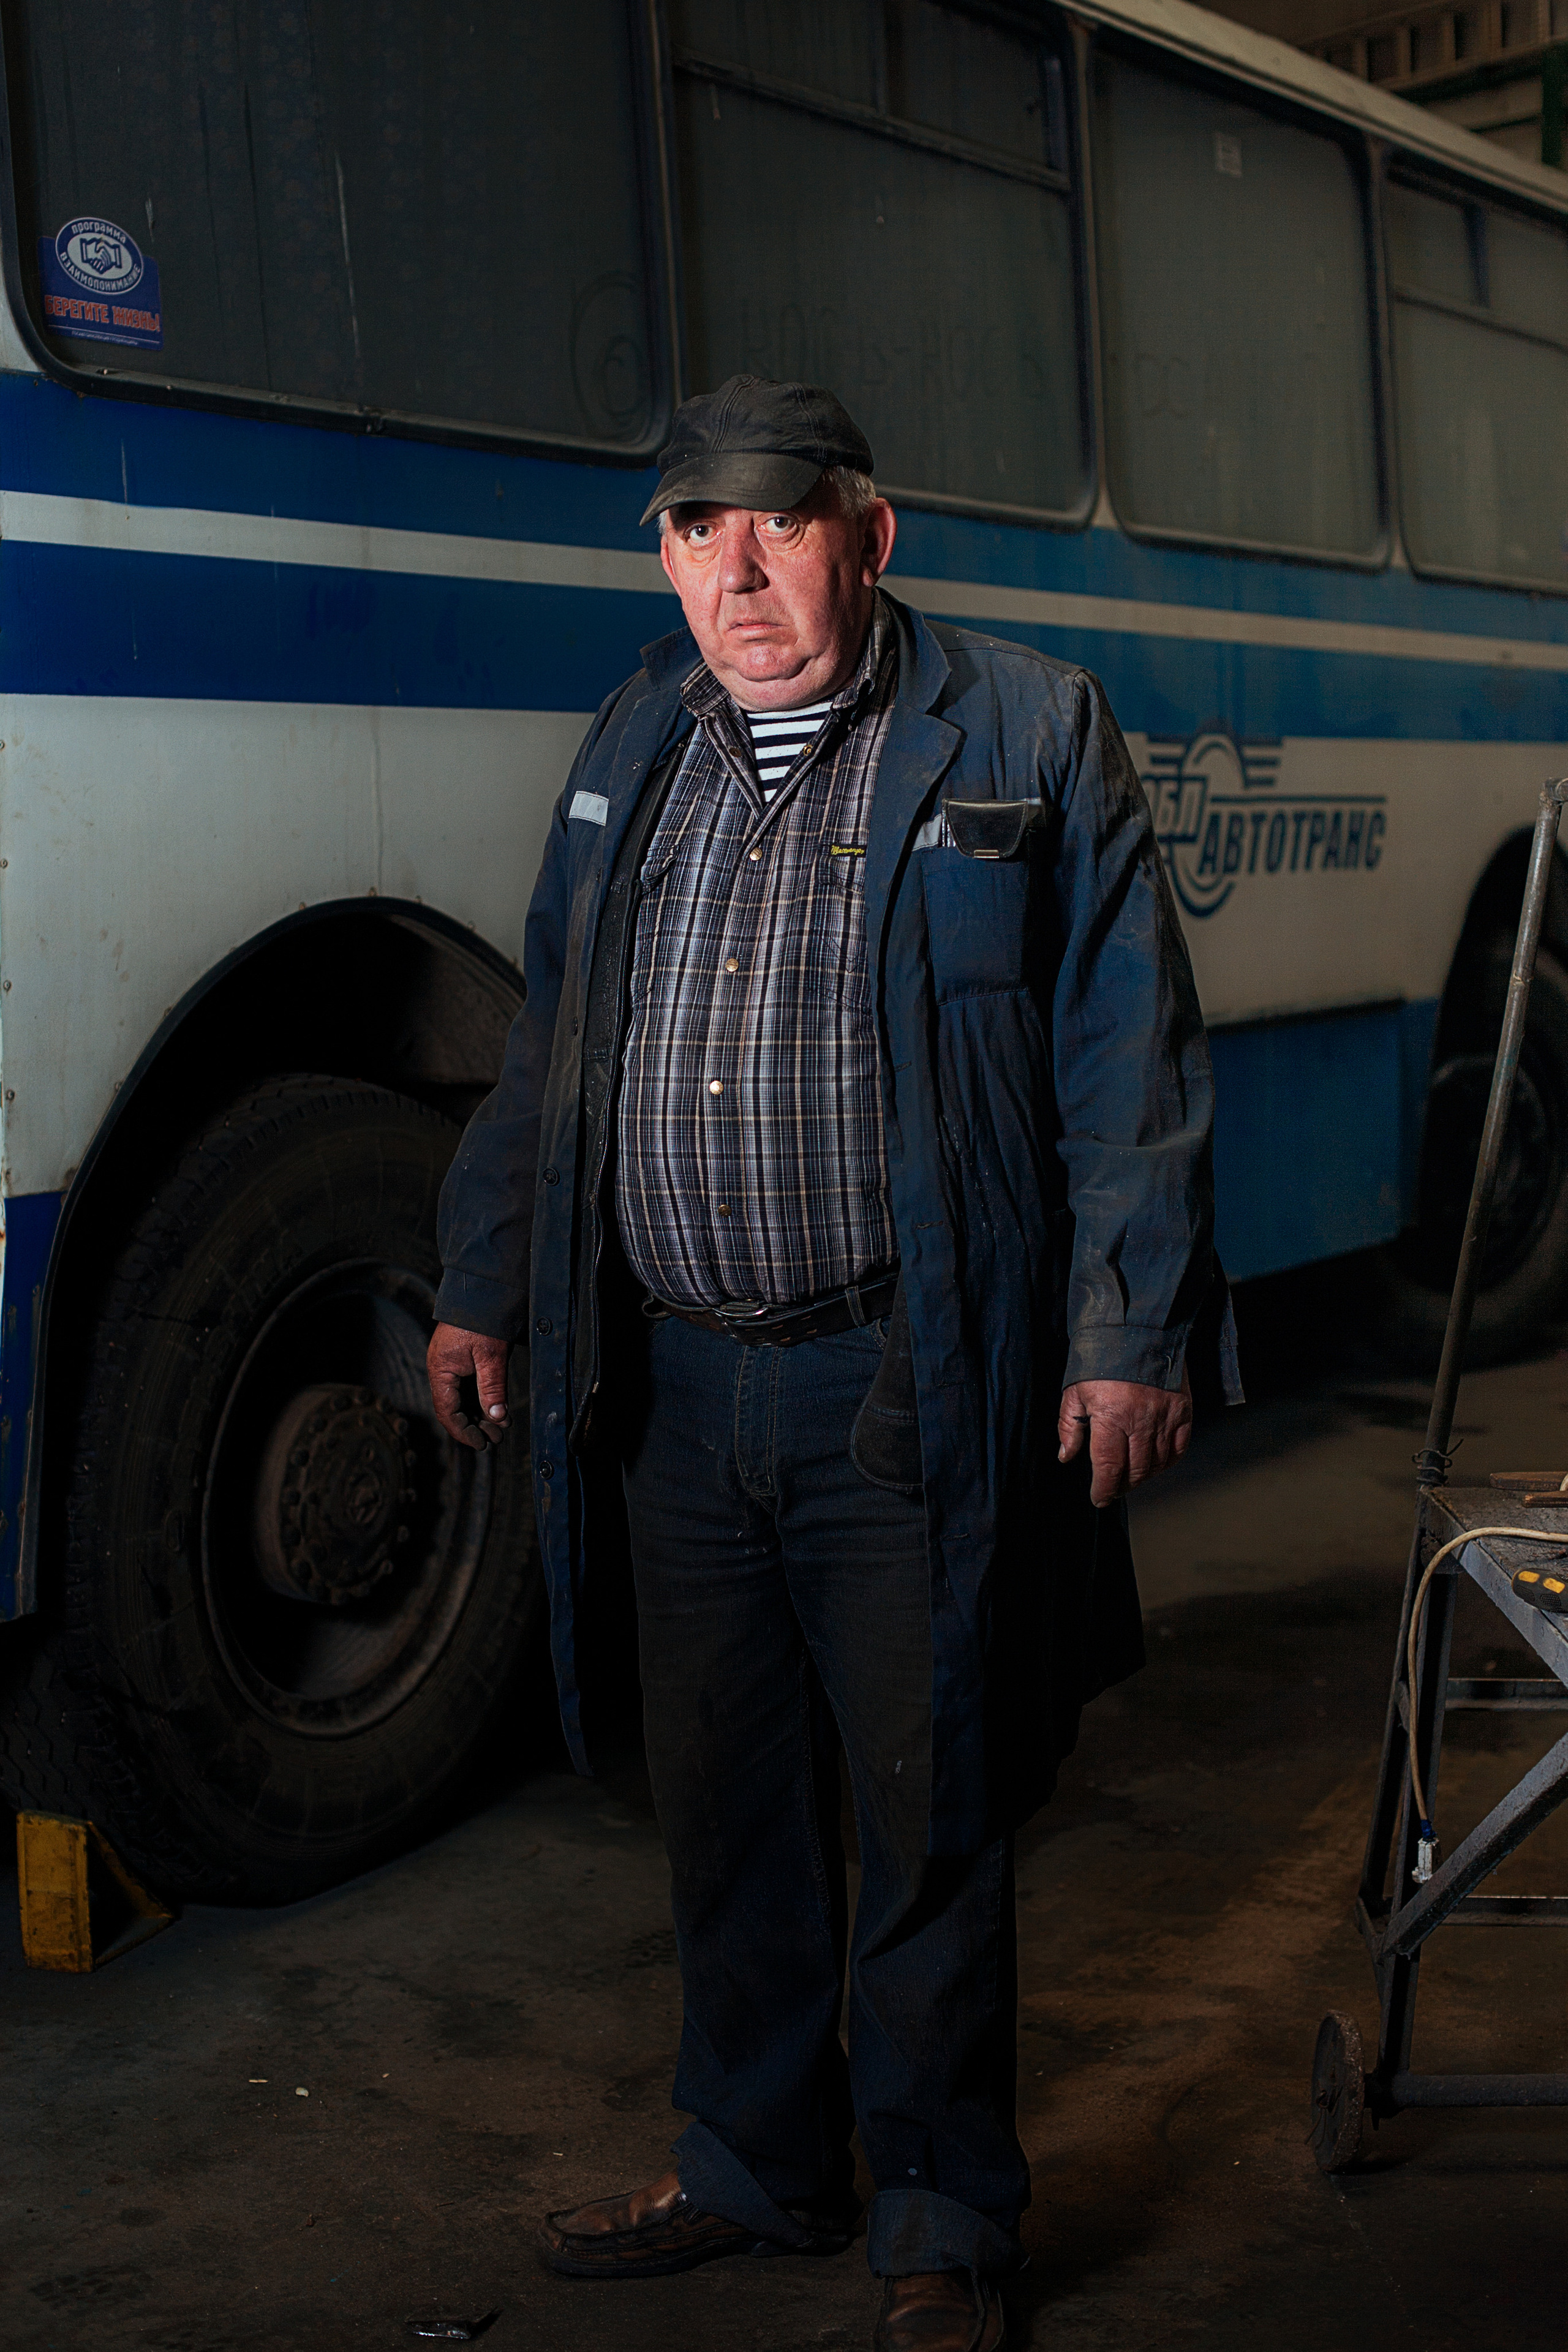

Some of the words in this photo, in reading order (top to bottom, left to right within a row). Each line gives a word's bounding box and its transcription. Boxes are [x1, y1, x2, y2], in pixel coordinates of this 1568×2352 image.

[60, 252, 141, 292] ВЗАИМОПОНИМАНИЕ
[44, 295, 109, 323] БЕРЕГИТЕ
[1198, 811, 1385, 875] АВТОТРАНС
